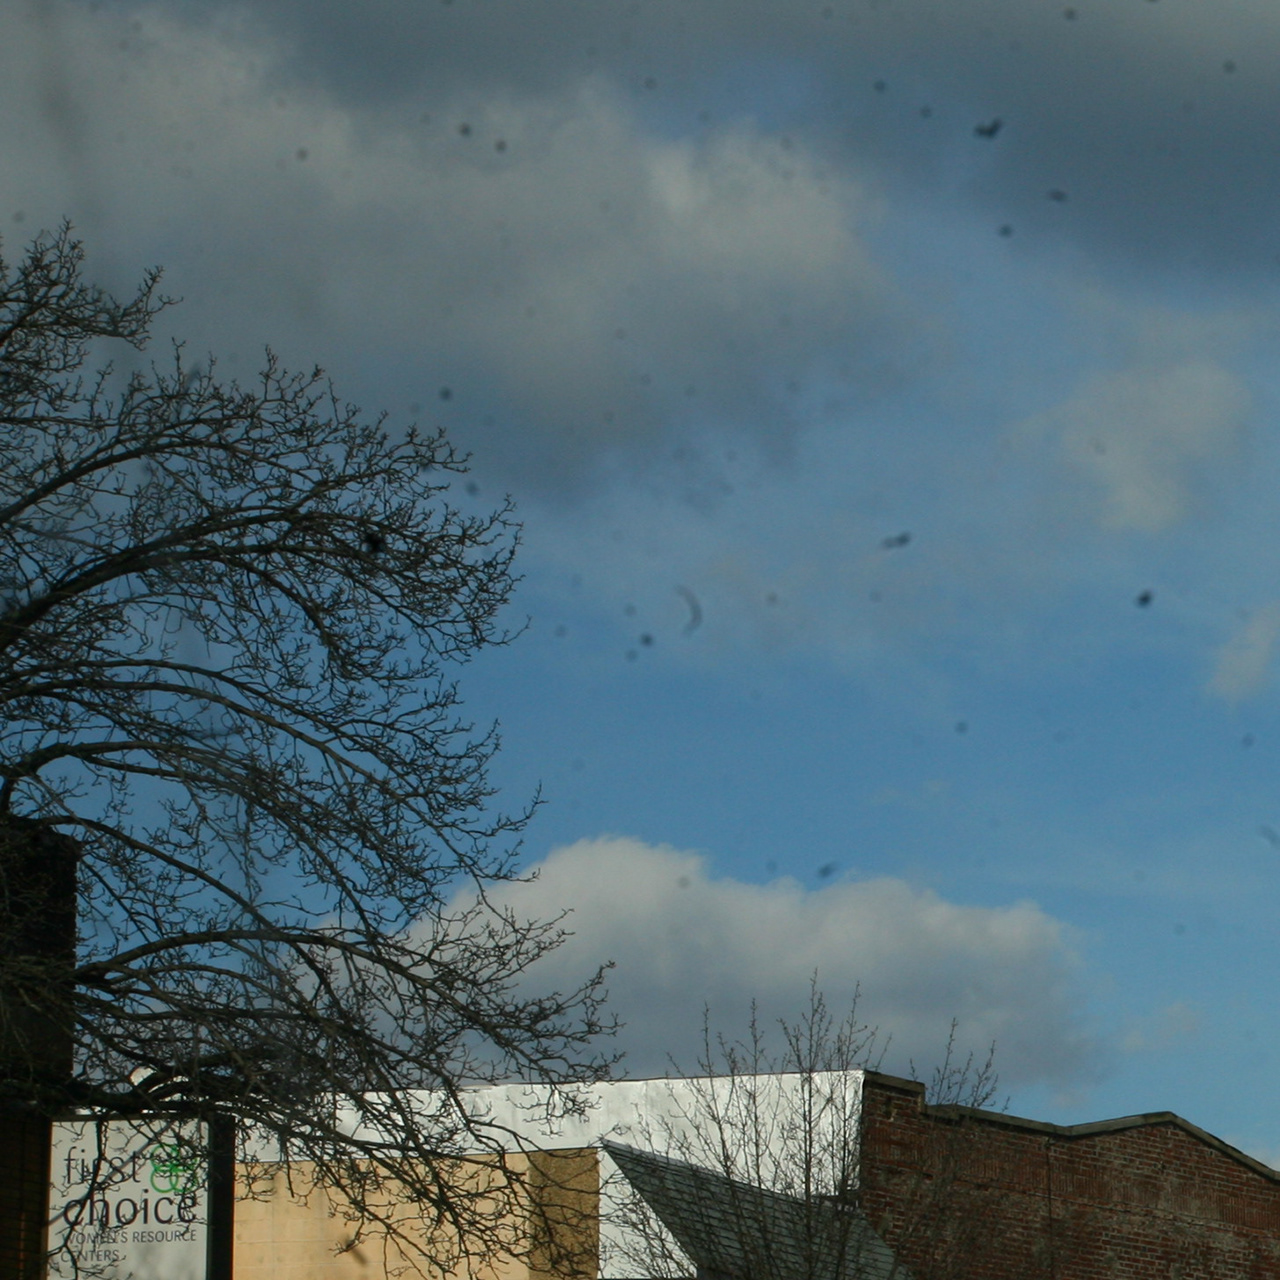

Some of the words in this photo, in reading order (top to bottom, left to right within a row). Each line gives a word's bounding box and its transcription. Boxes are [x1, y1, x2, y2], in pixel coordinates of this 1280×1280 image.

[64, 1146, 141, 1184] first
[63, 1188, 197, 1226] choice
[132, 1230, 197, 1243] RESOURCE
[60, 1250, 119, 1262] CENTERS
